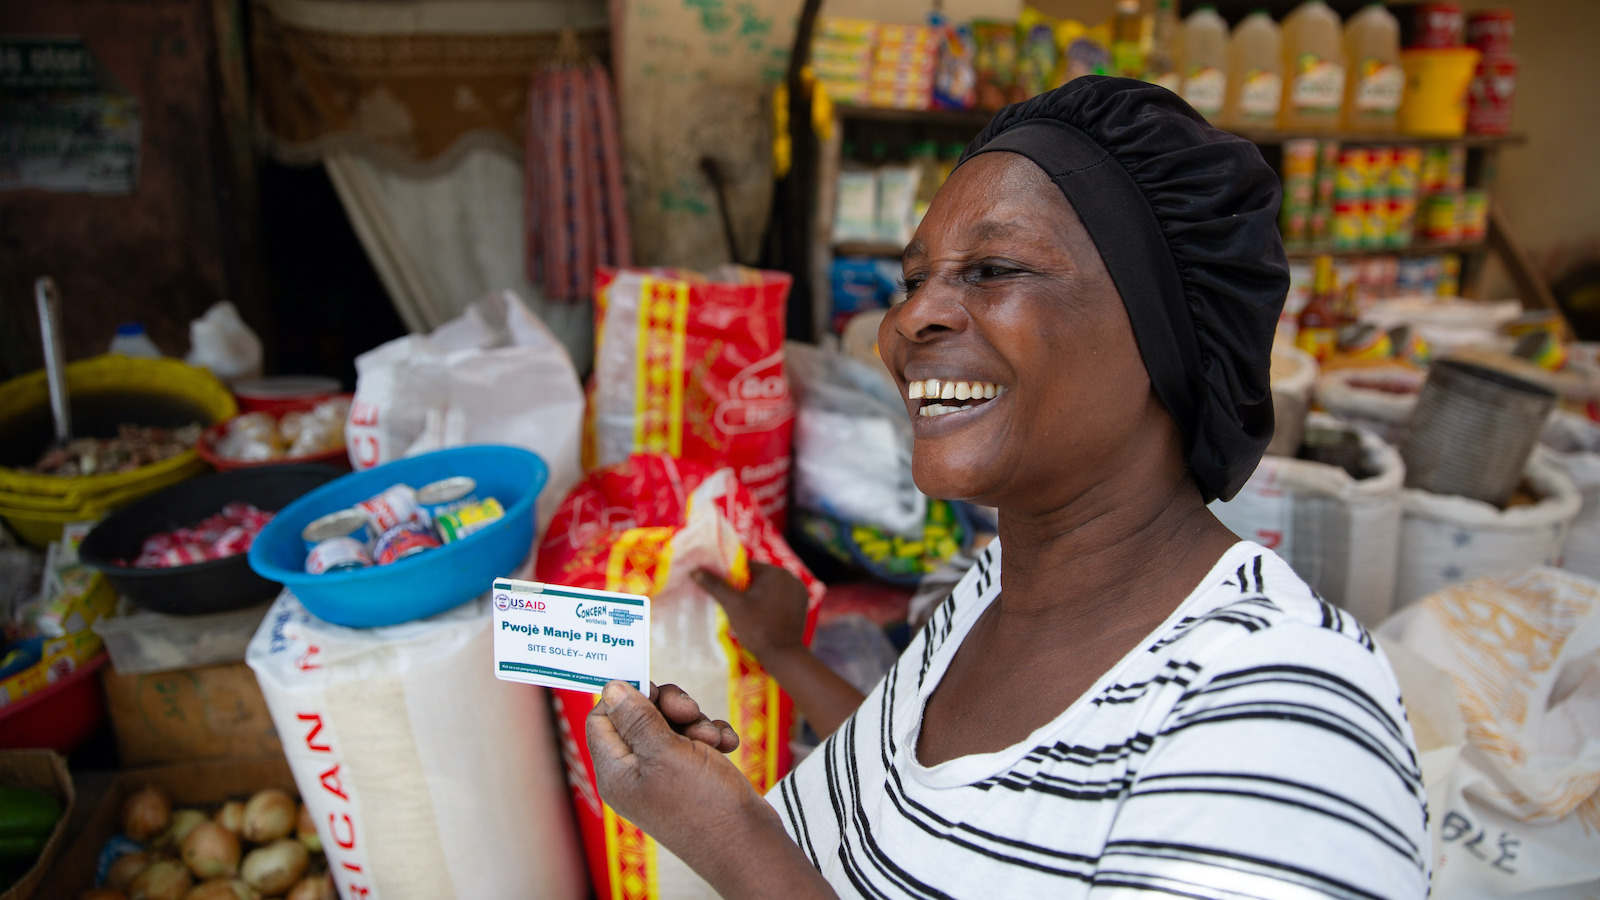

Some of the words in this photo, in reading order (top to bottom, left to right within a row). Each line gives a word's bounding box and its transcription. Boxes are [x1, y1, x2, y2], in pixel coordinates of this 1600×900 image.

[511, 598, 546, 611] USAID
[586, 618, 607, 626] worldwide
[502, 621, 539, 636] Pwojè
[543, 626, 581, 641] Manje
[585, 631, 598, 642] Pi
[602, 633, 635, 647] Byen
[527, 643, 547, 653] SITE
[585, 652, 608, 661] AYITI
